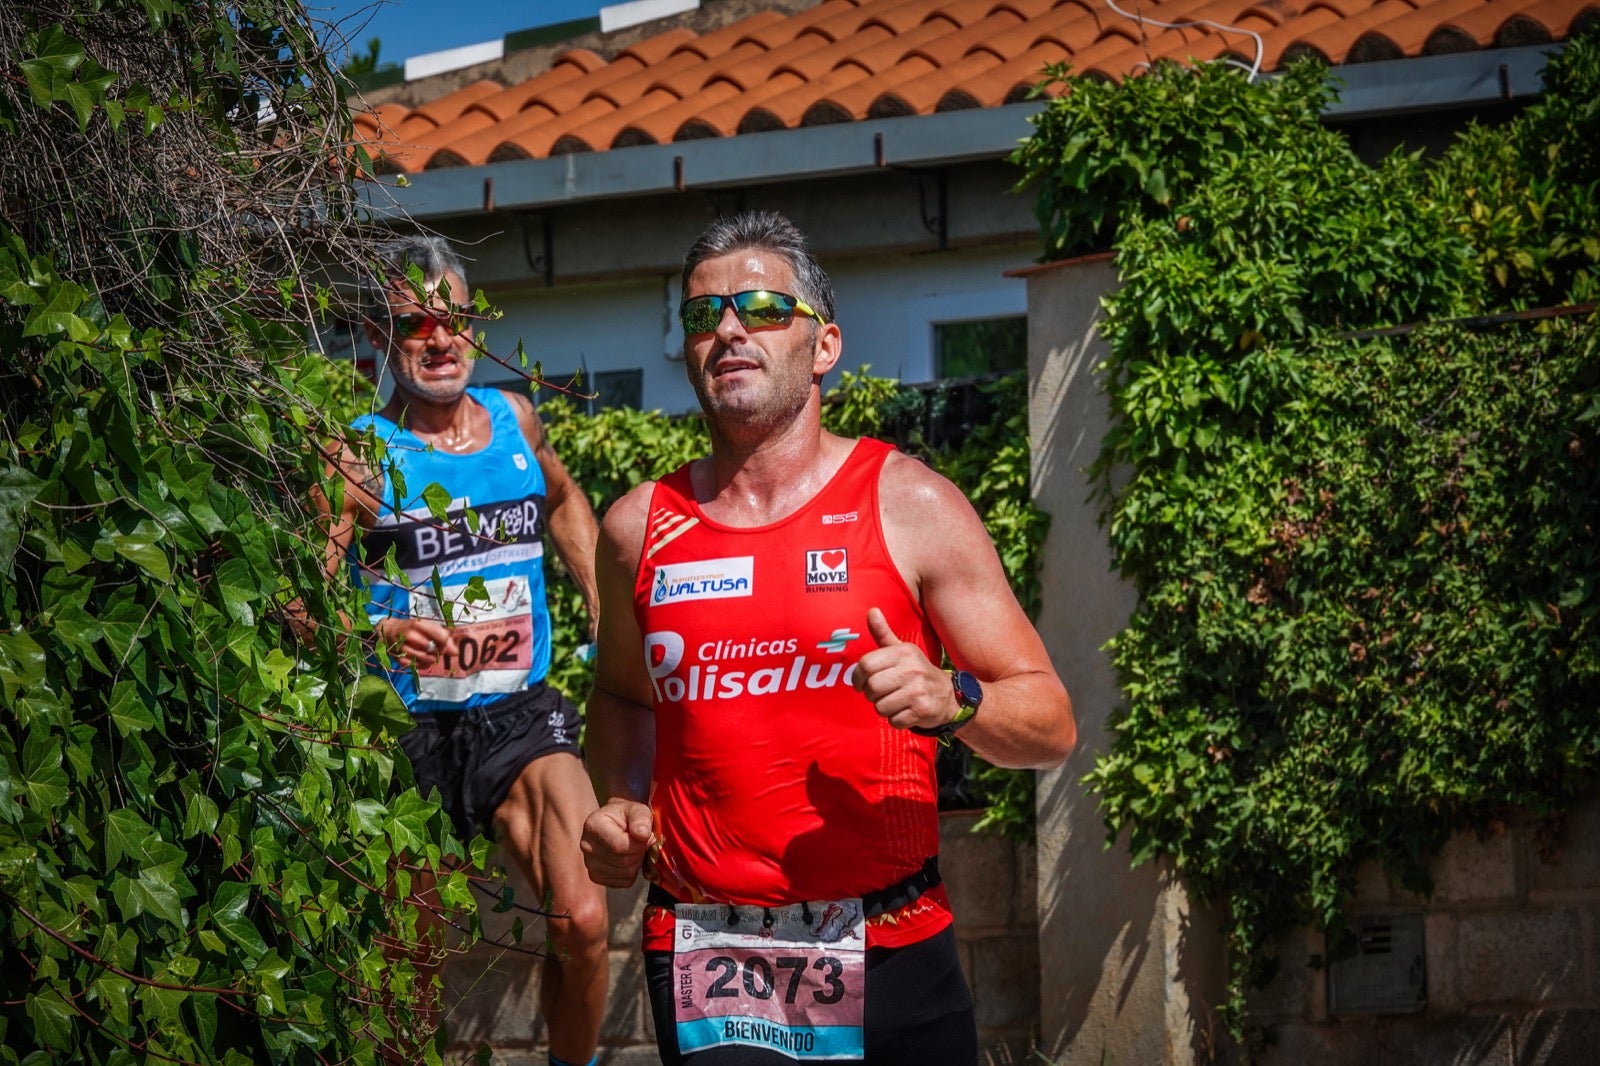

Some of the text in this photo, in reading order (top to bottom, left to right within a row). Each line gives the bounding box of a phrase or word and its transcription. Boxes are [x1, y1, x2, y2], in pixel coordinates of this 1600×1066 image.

[810, 553, 818, 572] I
[808, 571, 847, 583] MOVE
[806, 585, 848, 594] RUNNING
[698, 638, 798, 662] Clínicas
[680, 963, 692, 1009] MASTER A
[705, 956, 845, 1005] 2073
[724, 1020, 815, 1052] BIENVENIDO
